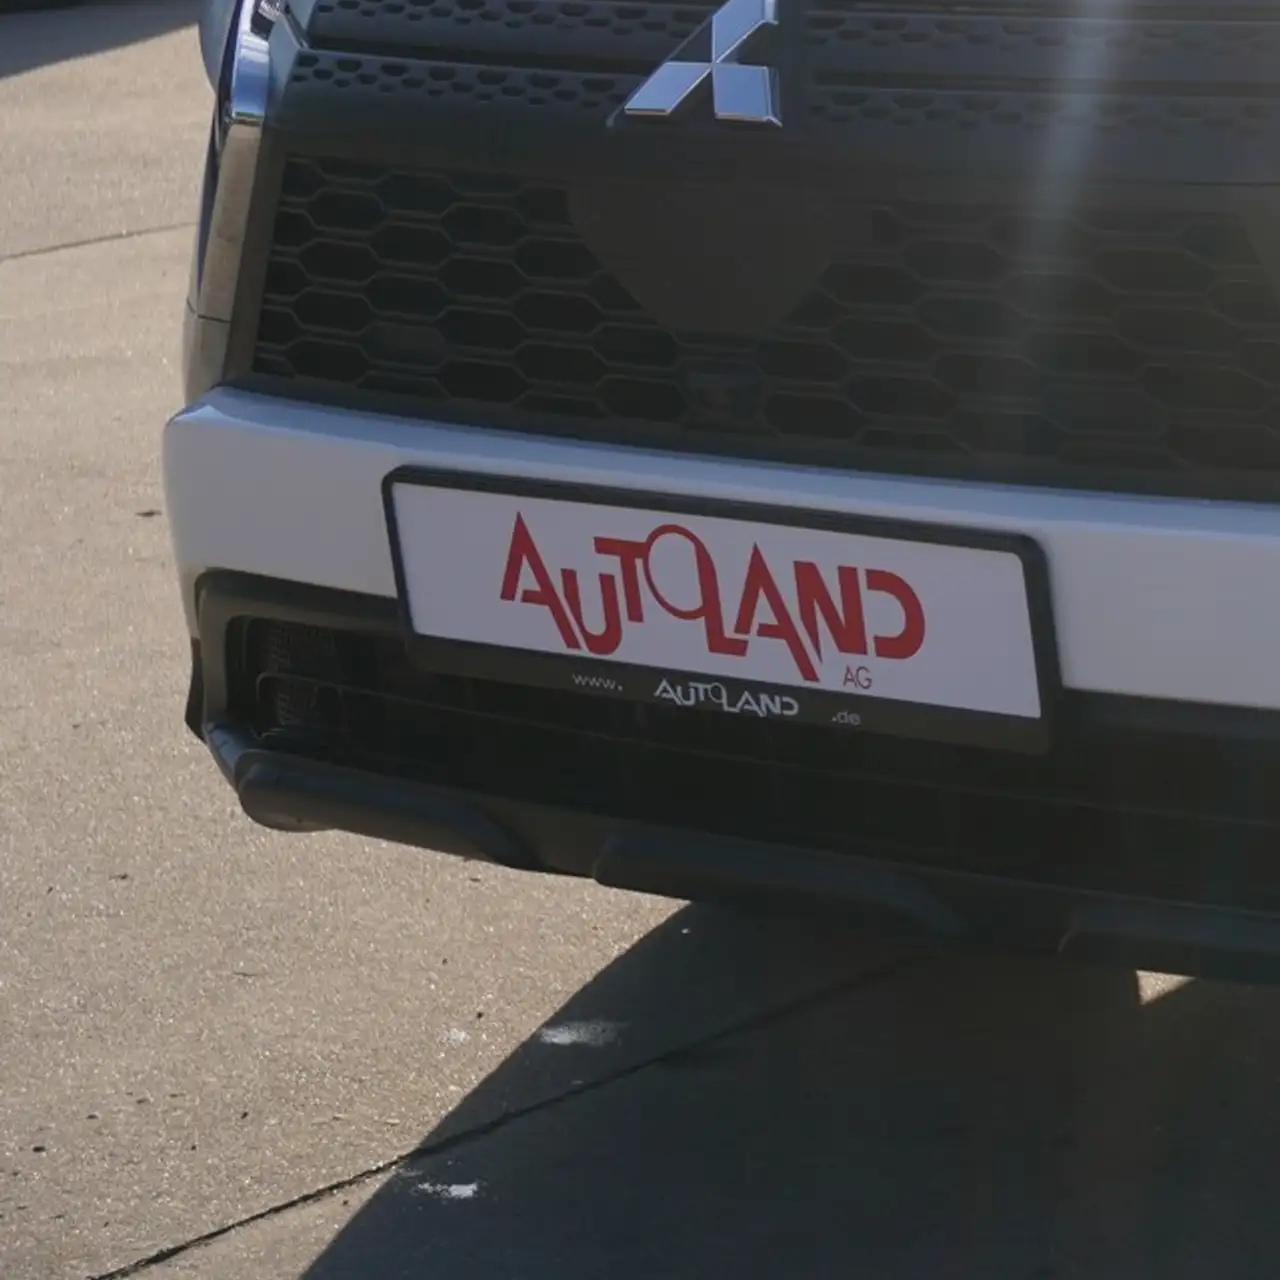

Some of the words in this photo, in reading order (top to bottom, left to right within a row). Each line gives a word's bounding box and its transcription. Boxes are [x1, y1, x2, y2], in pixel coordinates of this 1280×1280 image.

[500, 511, 925, 681] AUTOLAND
[572, 673, 624, 692] www.
[653, 678, 799, 717] AUTOLAND
[842, 665, 872, 690] AG
